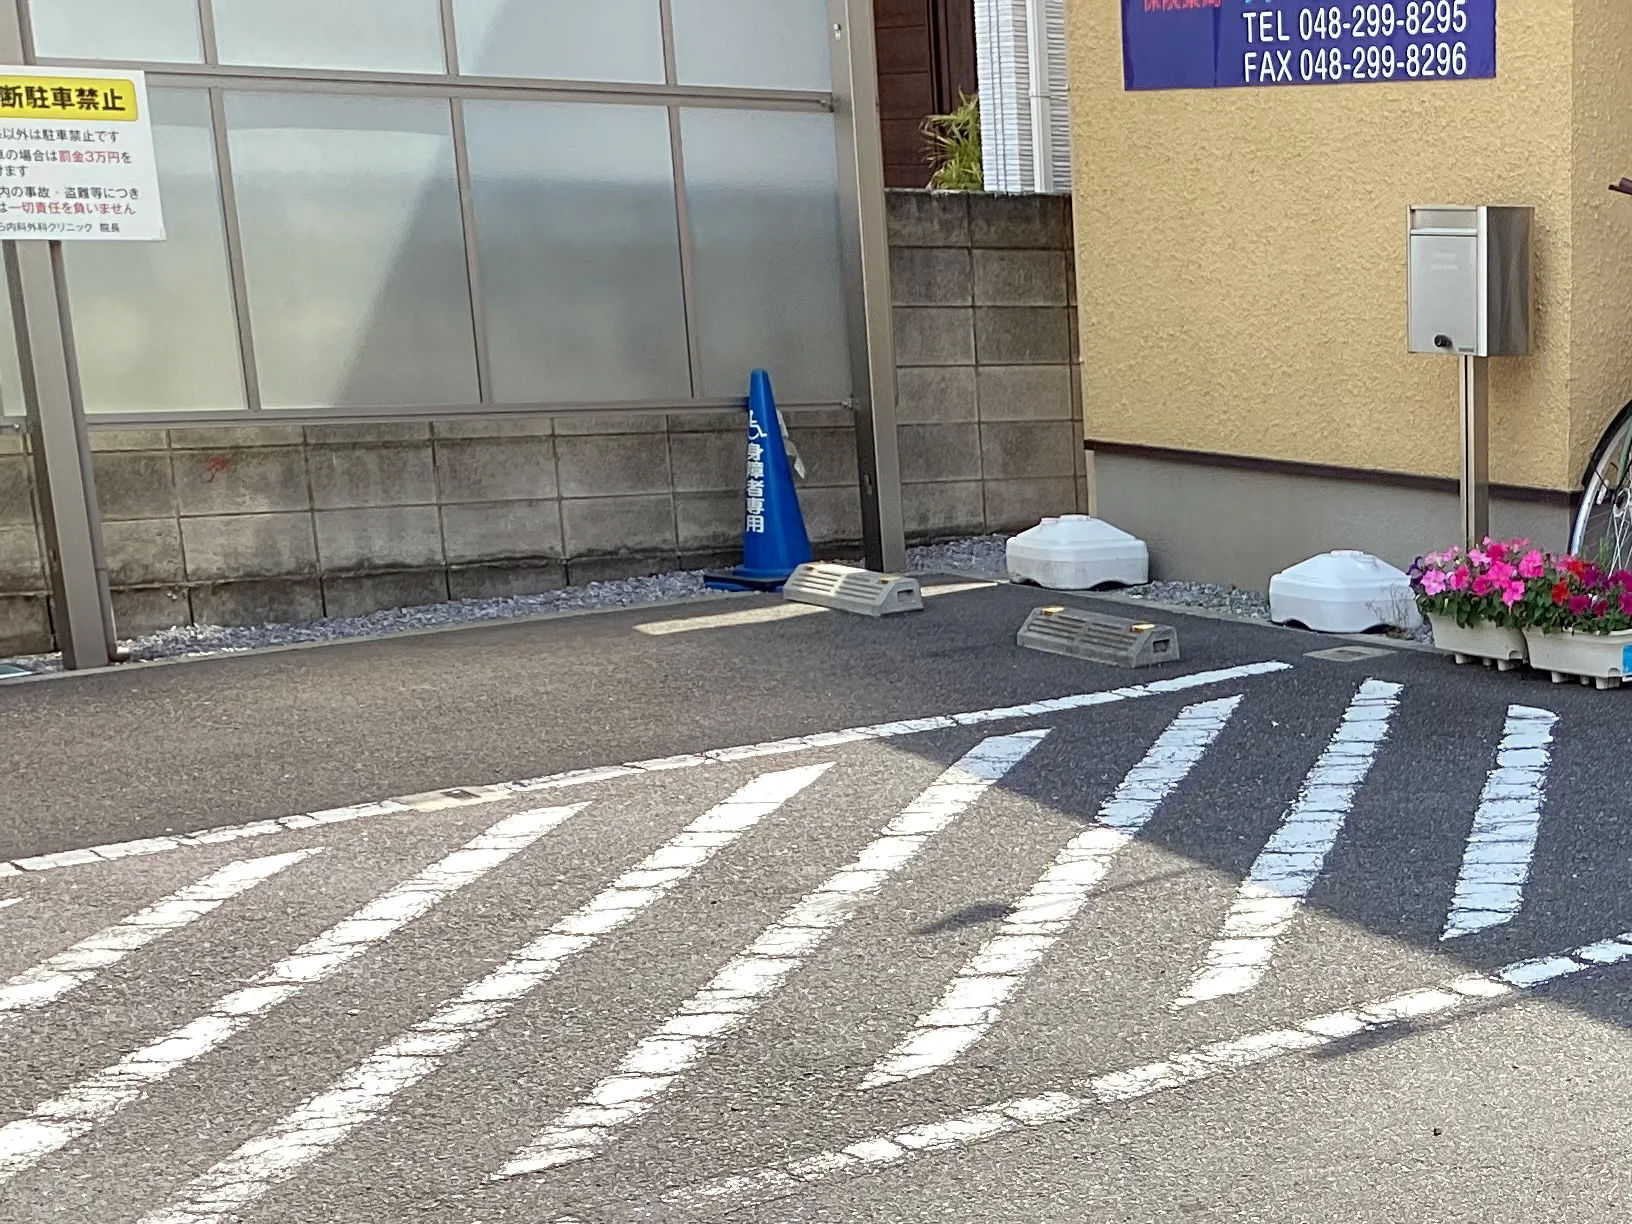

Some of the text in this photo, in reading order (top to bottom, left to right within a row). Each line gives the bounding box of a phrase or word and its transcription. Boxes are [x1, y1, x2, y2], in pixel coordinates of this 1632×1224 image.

[1243, 0, 1467, 43] TEL 048-299-8295
[1245, 41, 1467, 83] FAX 048-299-8296
[0, 84, 126, 112] 断駐車禁止
[0, 127, 120, 143] 以外は駐車禁止です
[0, 165, 29, 177] ます
